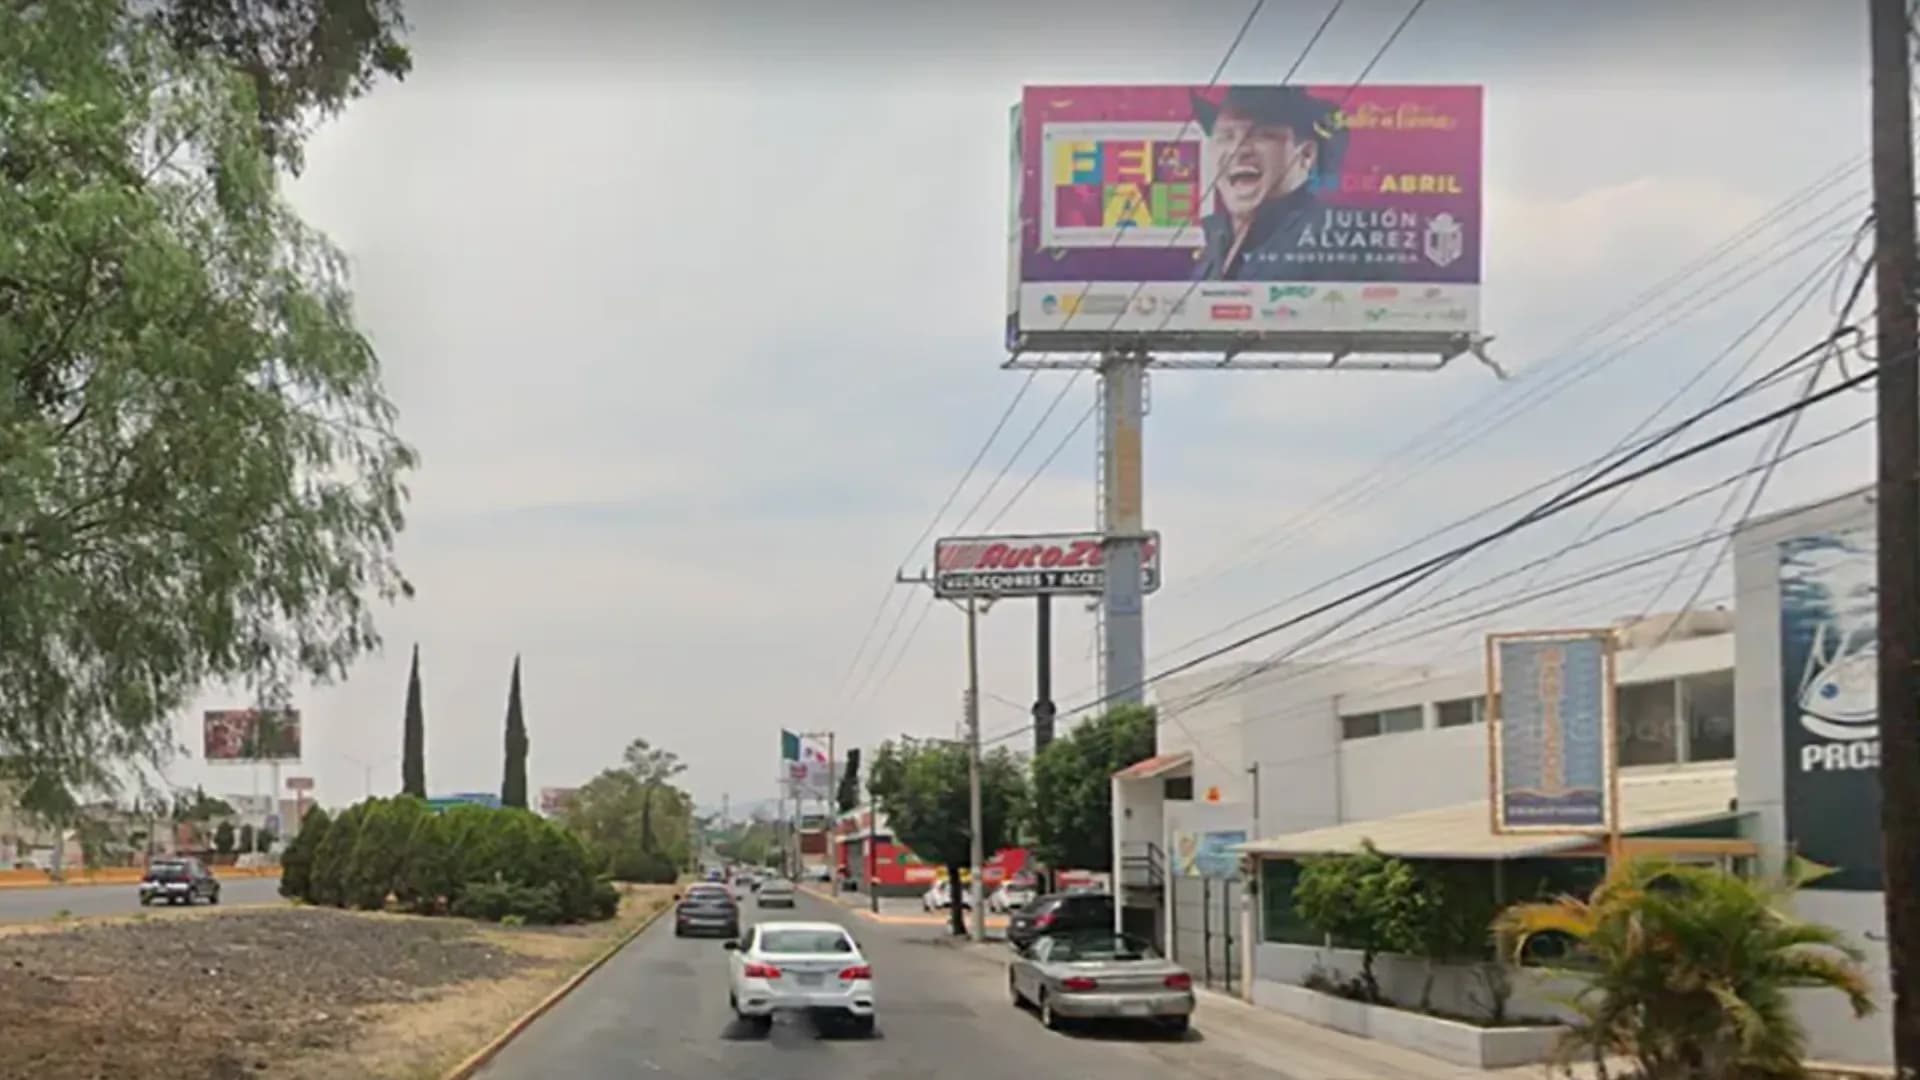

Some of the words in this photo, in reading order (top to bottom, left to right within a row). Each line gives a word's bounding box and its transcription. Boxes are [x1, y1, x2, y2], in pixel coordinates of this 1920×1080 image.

[1380, 174, 1462, 193] ABRIL
[1325, 208, 1417, 229] JULIÓN
[1297, 224, 1417, 248] ÁLVAREZ
